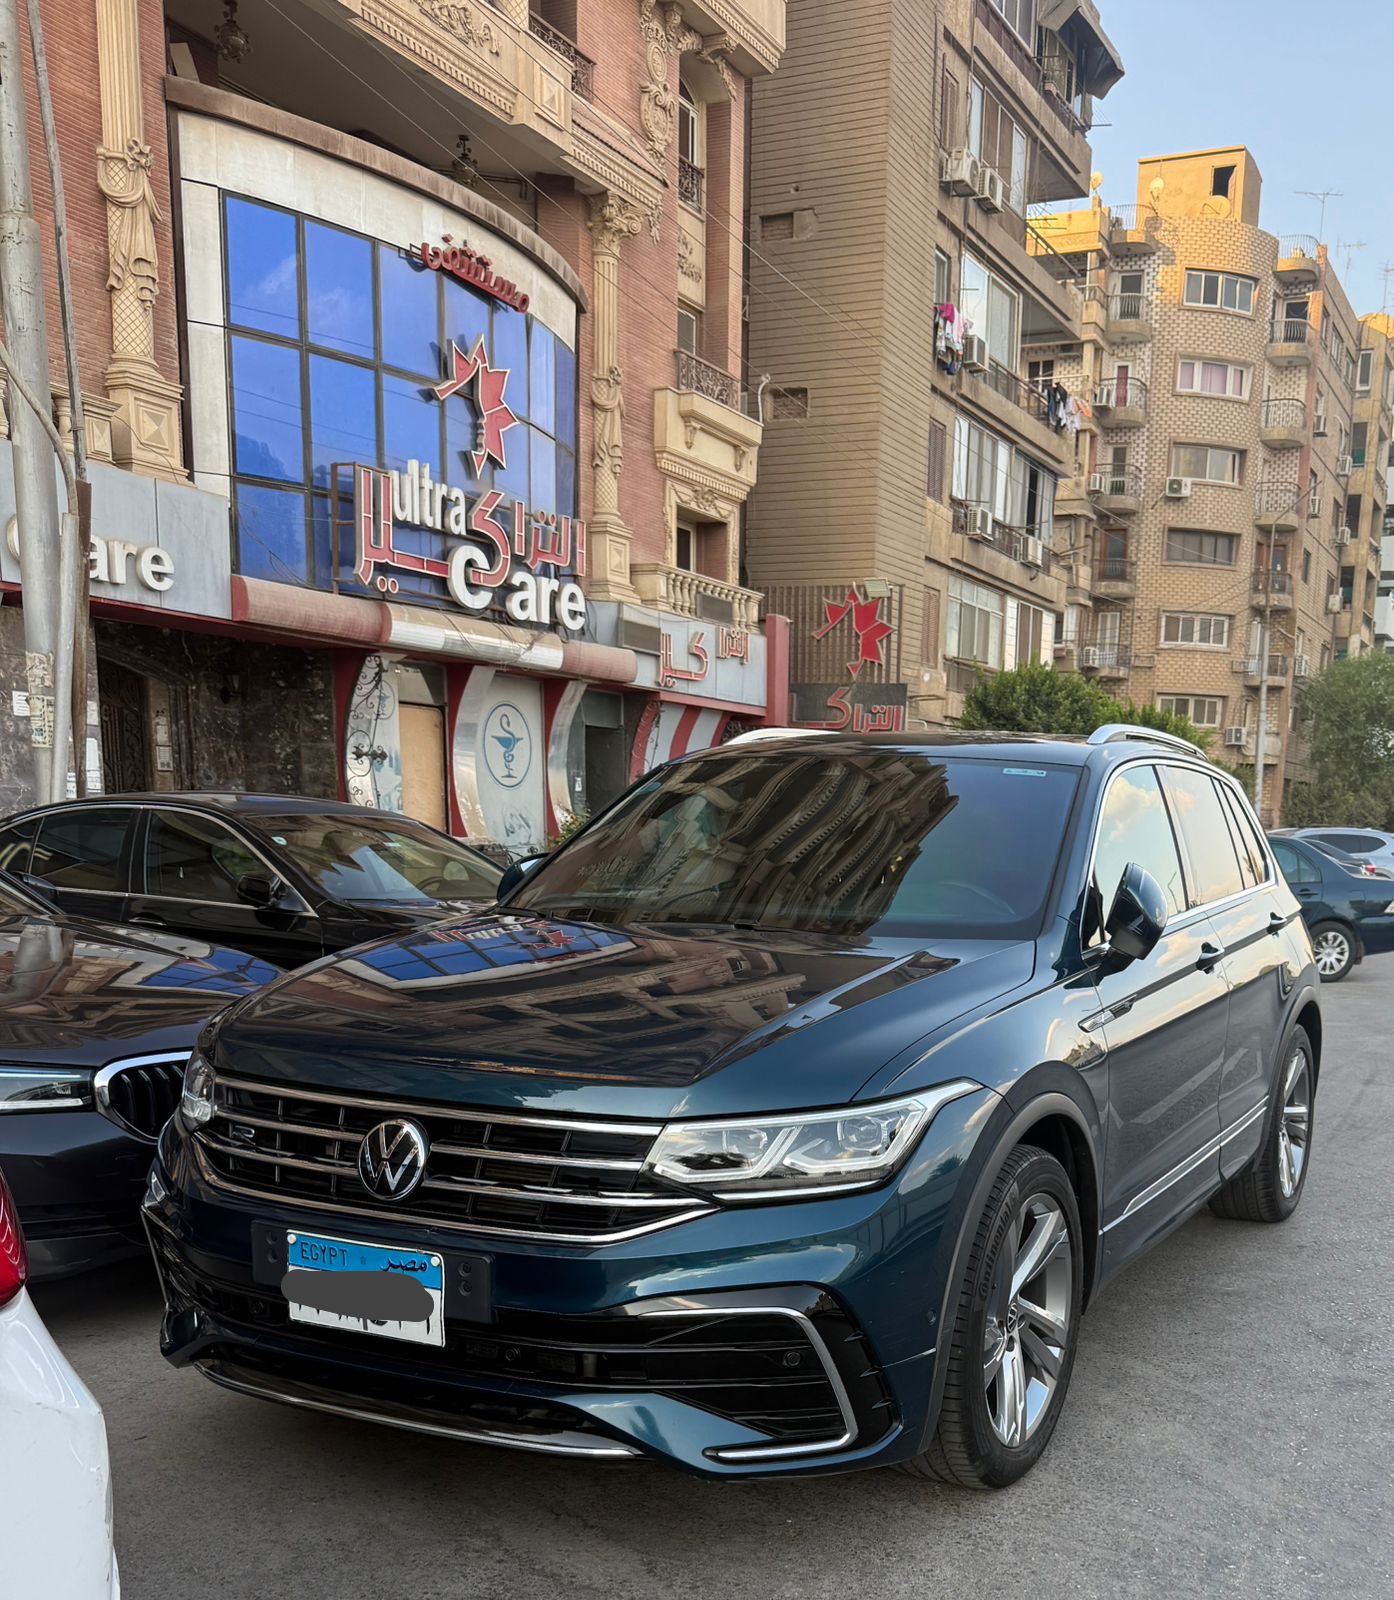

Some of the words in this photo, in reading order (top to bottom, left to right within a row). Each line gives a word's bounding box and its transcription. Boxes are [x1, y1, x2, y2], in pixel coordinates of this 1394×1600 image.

[391, 459, 467, 536] ultra
[300, 1241, 349, 1267] EGYPT
[379, 1255, 428, 1273] مصر
